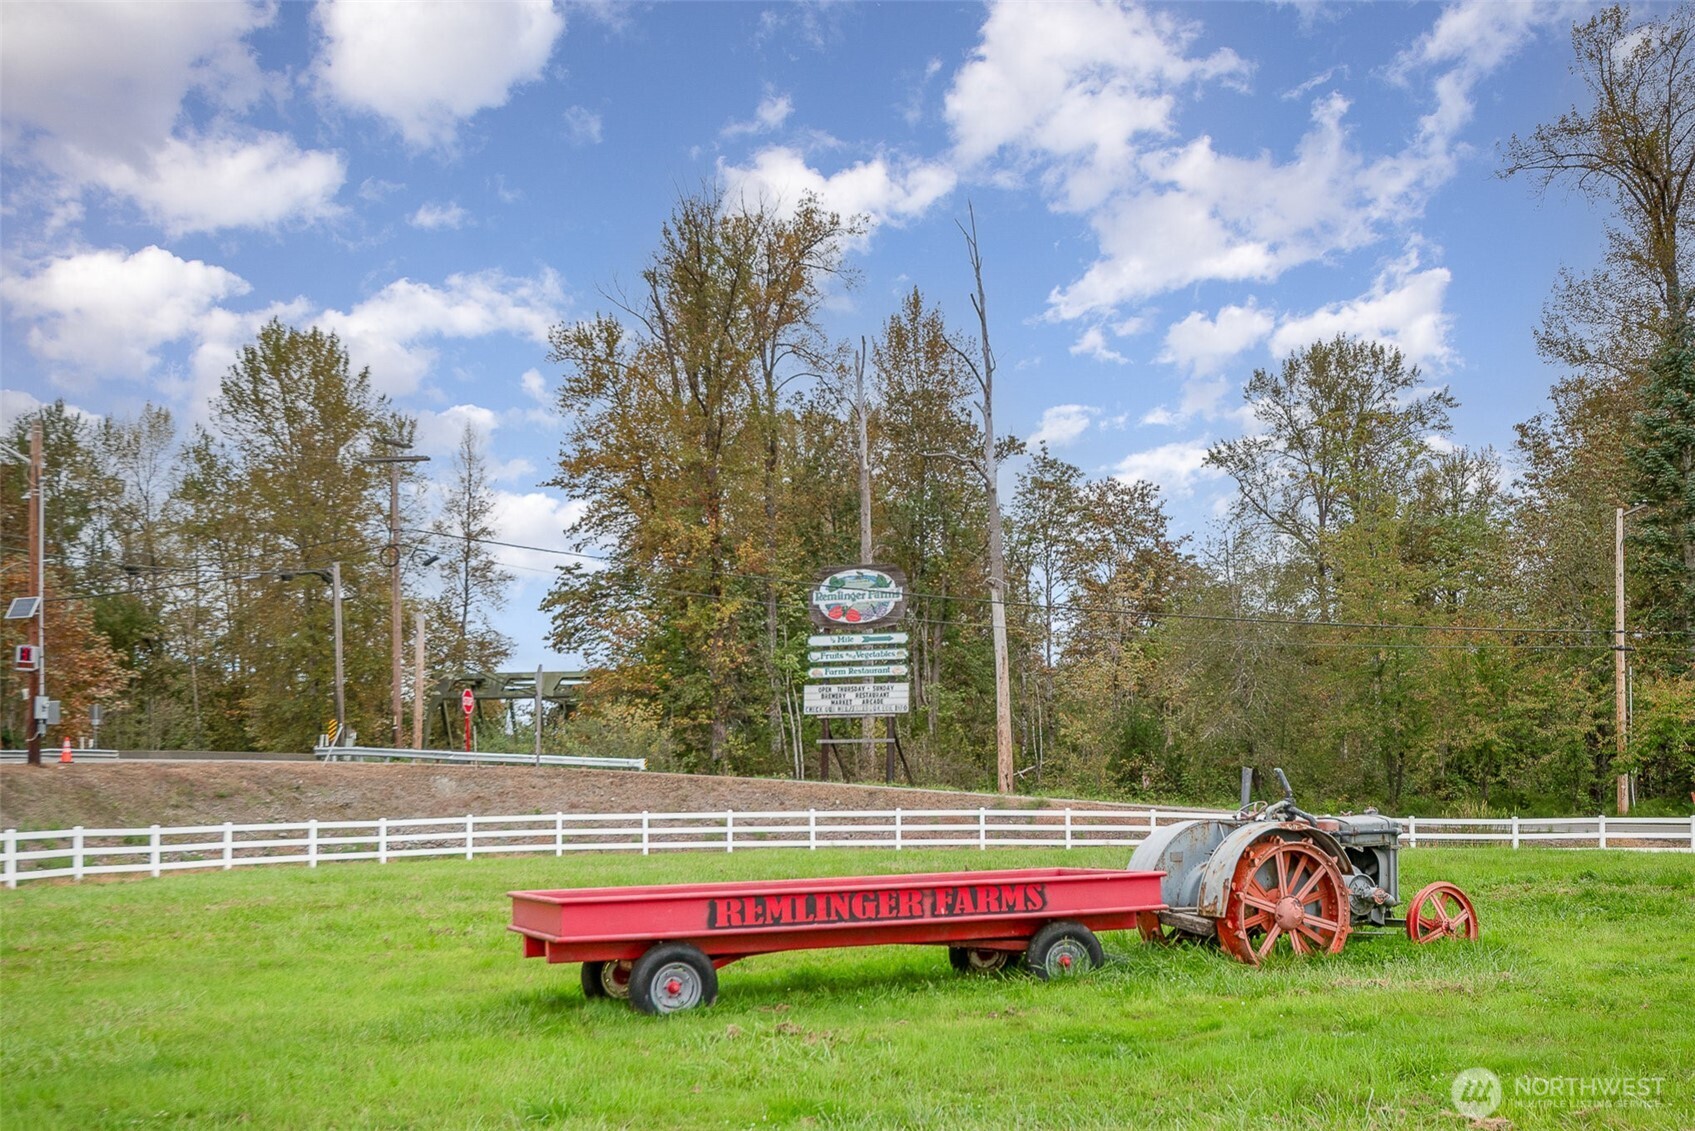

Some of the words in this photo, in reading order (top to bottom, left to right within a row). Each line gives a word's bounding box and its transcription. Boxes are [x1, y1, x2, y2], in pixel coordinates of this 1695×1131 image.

[815, 591, 866, 602] Remlinger
[868, 590, 901, 600] Farms
[837, 635, 855, 643] Mile
[820, 652, 844, 660] Fruits
[855, 650, 896, 660] Vegetables
[824, 667, 846, 676] Farm
[848, 666, 890, 674] Restaurant
[714, 888, 924, 927] REMLINGER
[931, 883, 1045, 914] FARMS
